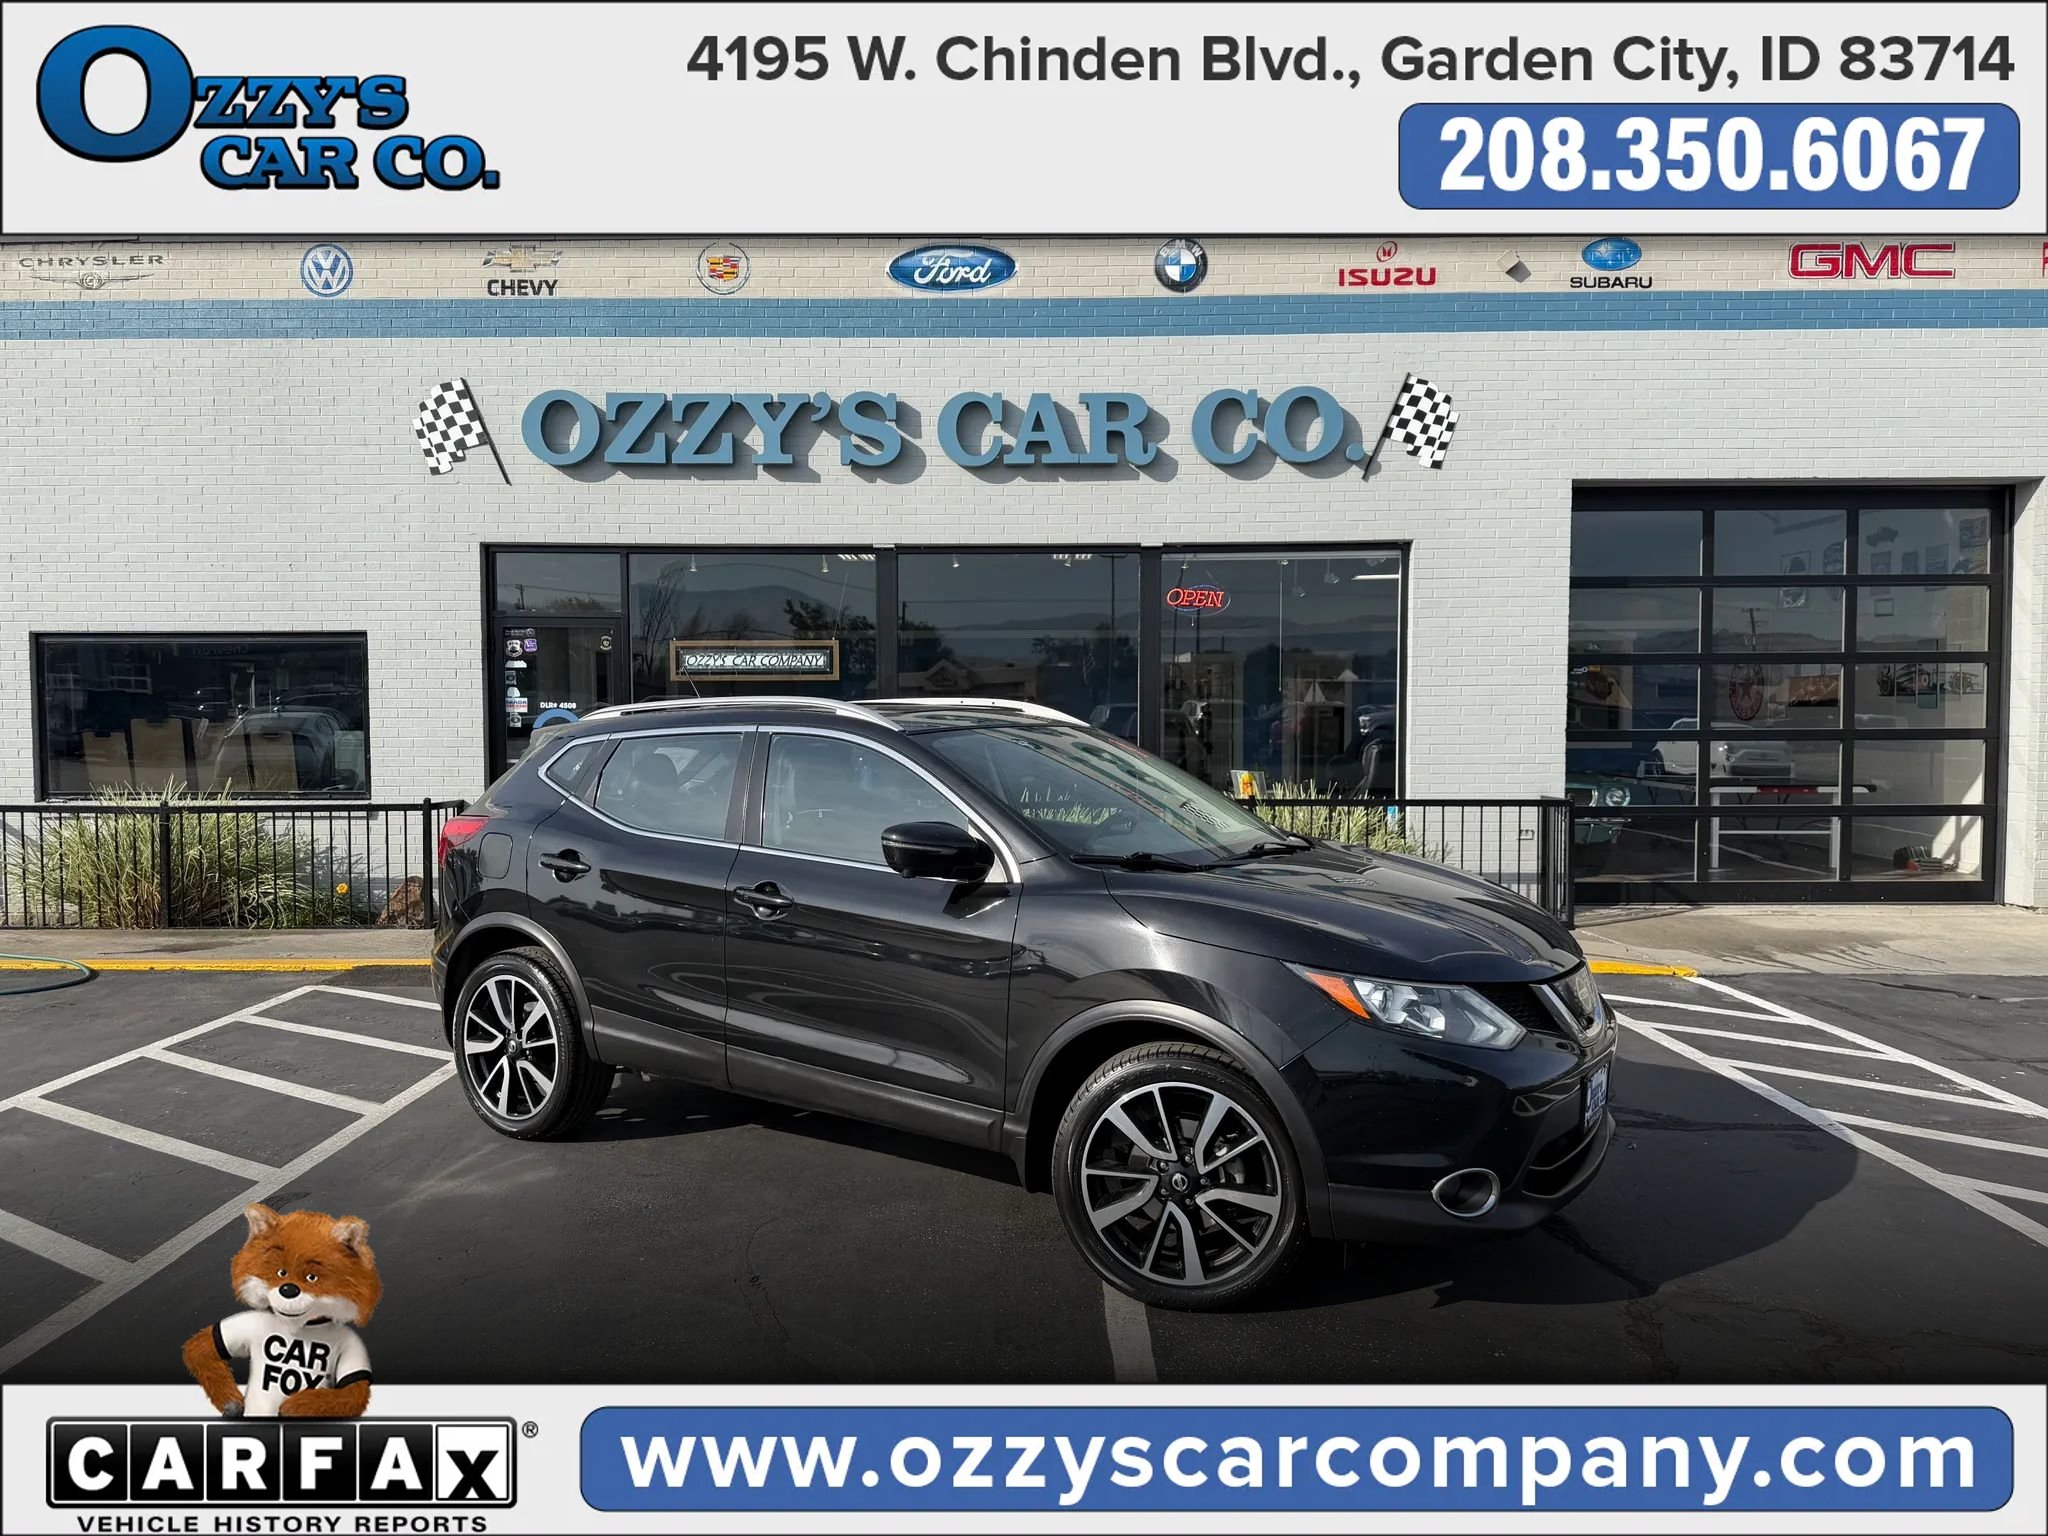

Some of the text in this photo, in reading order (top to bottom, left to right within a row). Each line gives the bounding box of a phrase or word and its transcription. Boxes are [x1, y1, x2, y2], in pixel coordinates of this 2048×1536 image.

[1159, 239, 1203, 257] BMW
[18, 254, 164, 267] CHRYSLER
[914, 255, 993, 284] Ford
[1789, 243, 1955, 279] GMC
[1339, 267, 1436, 286] ISUZU
[1570, 277, 1653, 289] SUBARU
[487, 280, 558, 297] CHEVY
[521, 387, 1364, 469] OZZY'S CAR CO.
[1167, 588, 1224, 607] OPEN
[686, 655, 823, 667] OZZY'S CAR COMPANY
